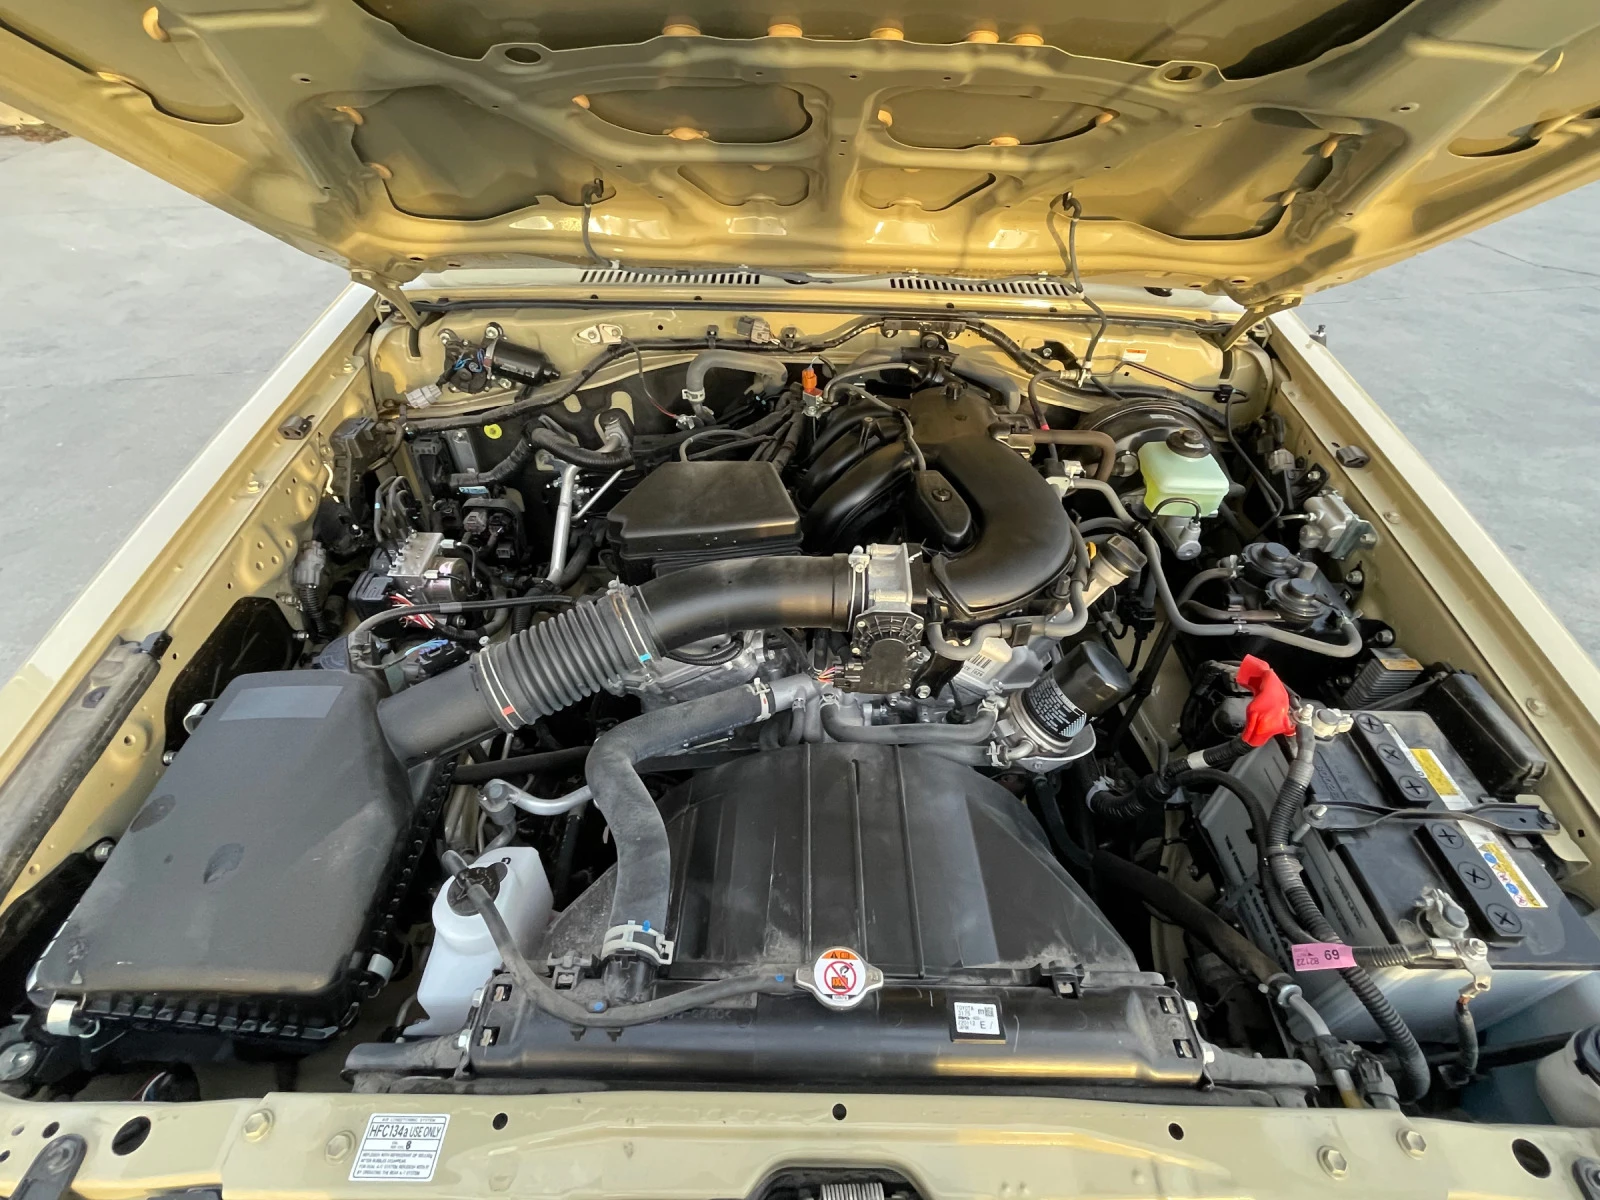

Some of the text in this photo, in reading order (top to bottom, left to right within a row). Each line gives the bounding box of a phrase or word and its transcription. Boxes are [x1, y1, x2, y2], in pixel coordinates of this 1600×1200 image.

[1324, 949, 1340, 960] 69
[369, 1125, 442, 1138] HFC134a USE ONLY
[406, 1140, 412, 1150] 8
